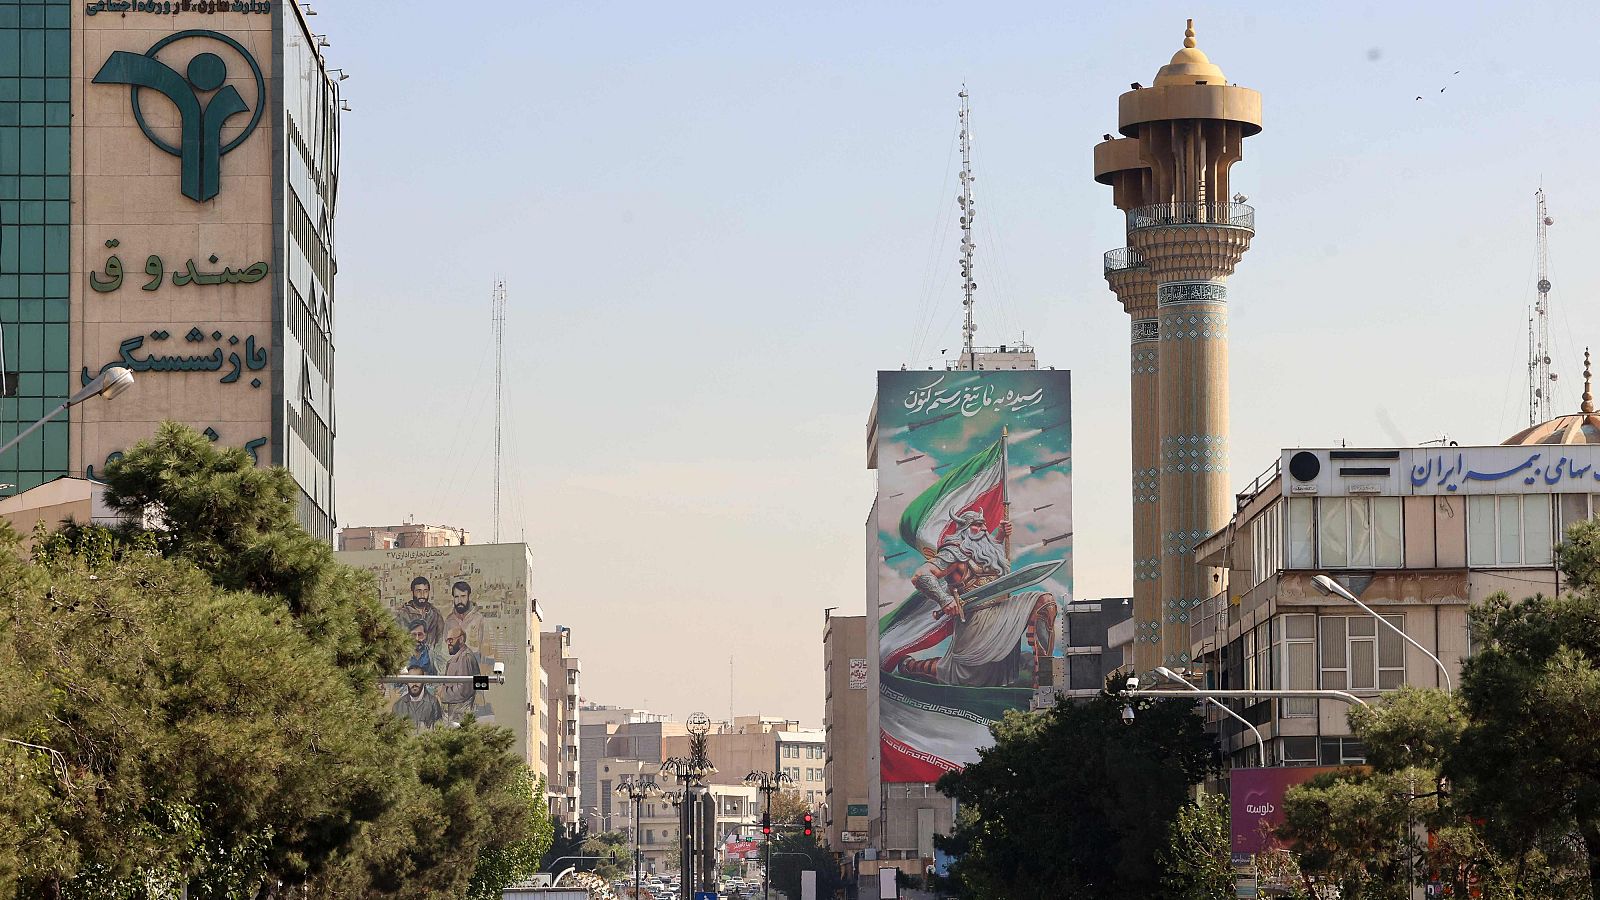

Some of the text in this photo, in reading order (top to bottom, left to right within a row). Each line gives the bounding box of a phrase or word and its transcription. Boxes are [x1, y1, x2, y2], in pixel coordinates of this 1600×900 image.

[81, 326, 267, 389] بازنشستگی
[925, 388, 961, 415] رستم
[960, 385, 984, 417] تیغ
[1005, 388, 1043, 412] رسیده
[1410, 453, 1462, 491] ایران
[1462, 453, 1541, 485] بیمه
[1544, 456, 1592, 485] سهامی
